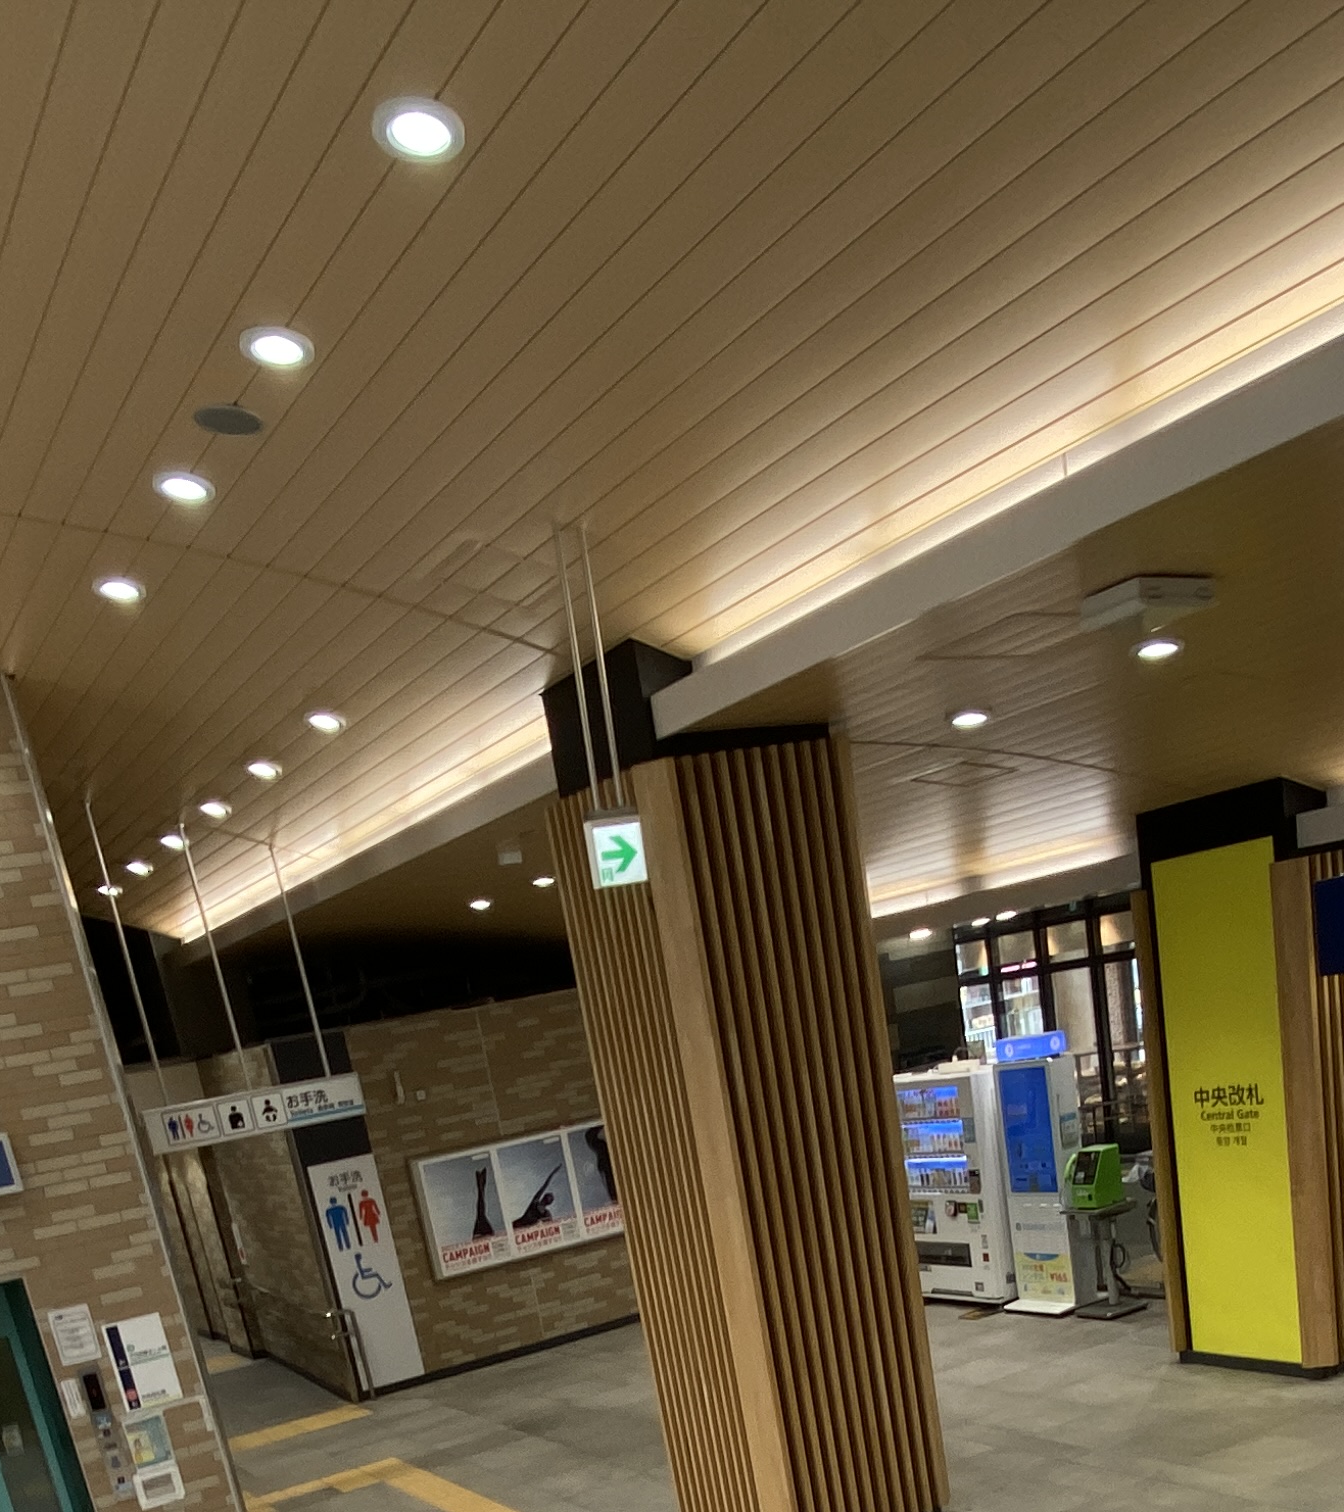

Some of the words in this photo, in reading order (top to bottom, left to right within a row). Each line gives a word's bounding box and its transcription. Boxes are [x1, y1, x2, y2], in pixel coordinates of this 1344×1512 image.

[287, 1090, 329, 1109] お手洗
[1194, 1083, 1264, 1109] 中央改札
[1201, 1109, 1234, 1121] Central
[1237, 1109, 1259, 1119] Gate
[515, 1225, 561, 1245] CAMPAIGN
[443, 1242, 490, 1263] CAMPAIGN
